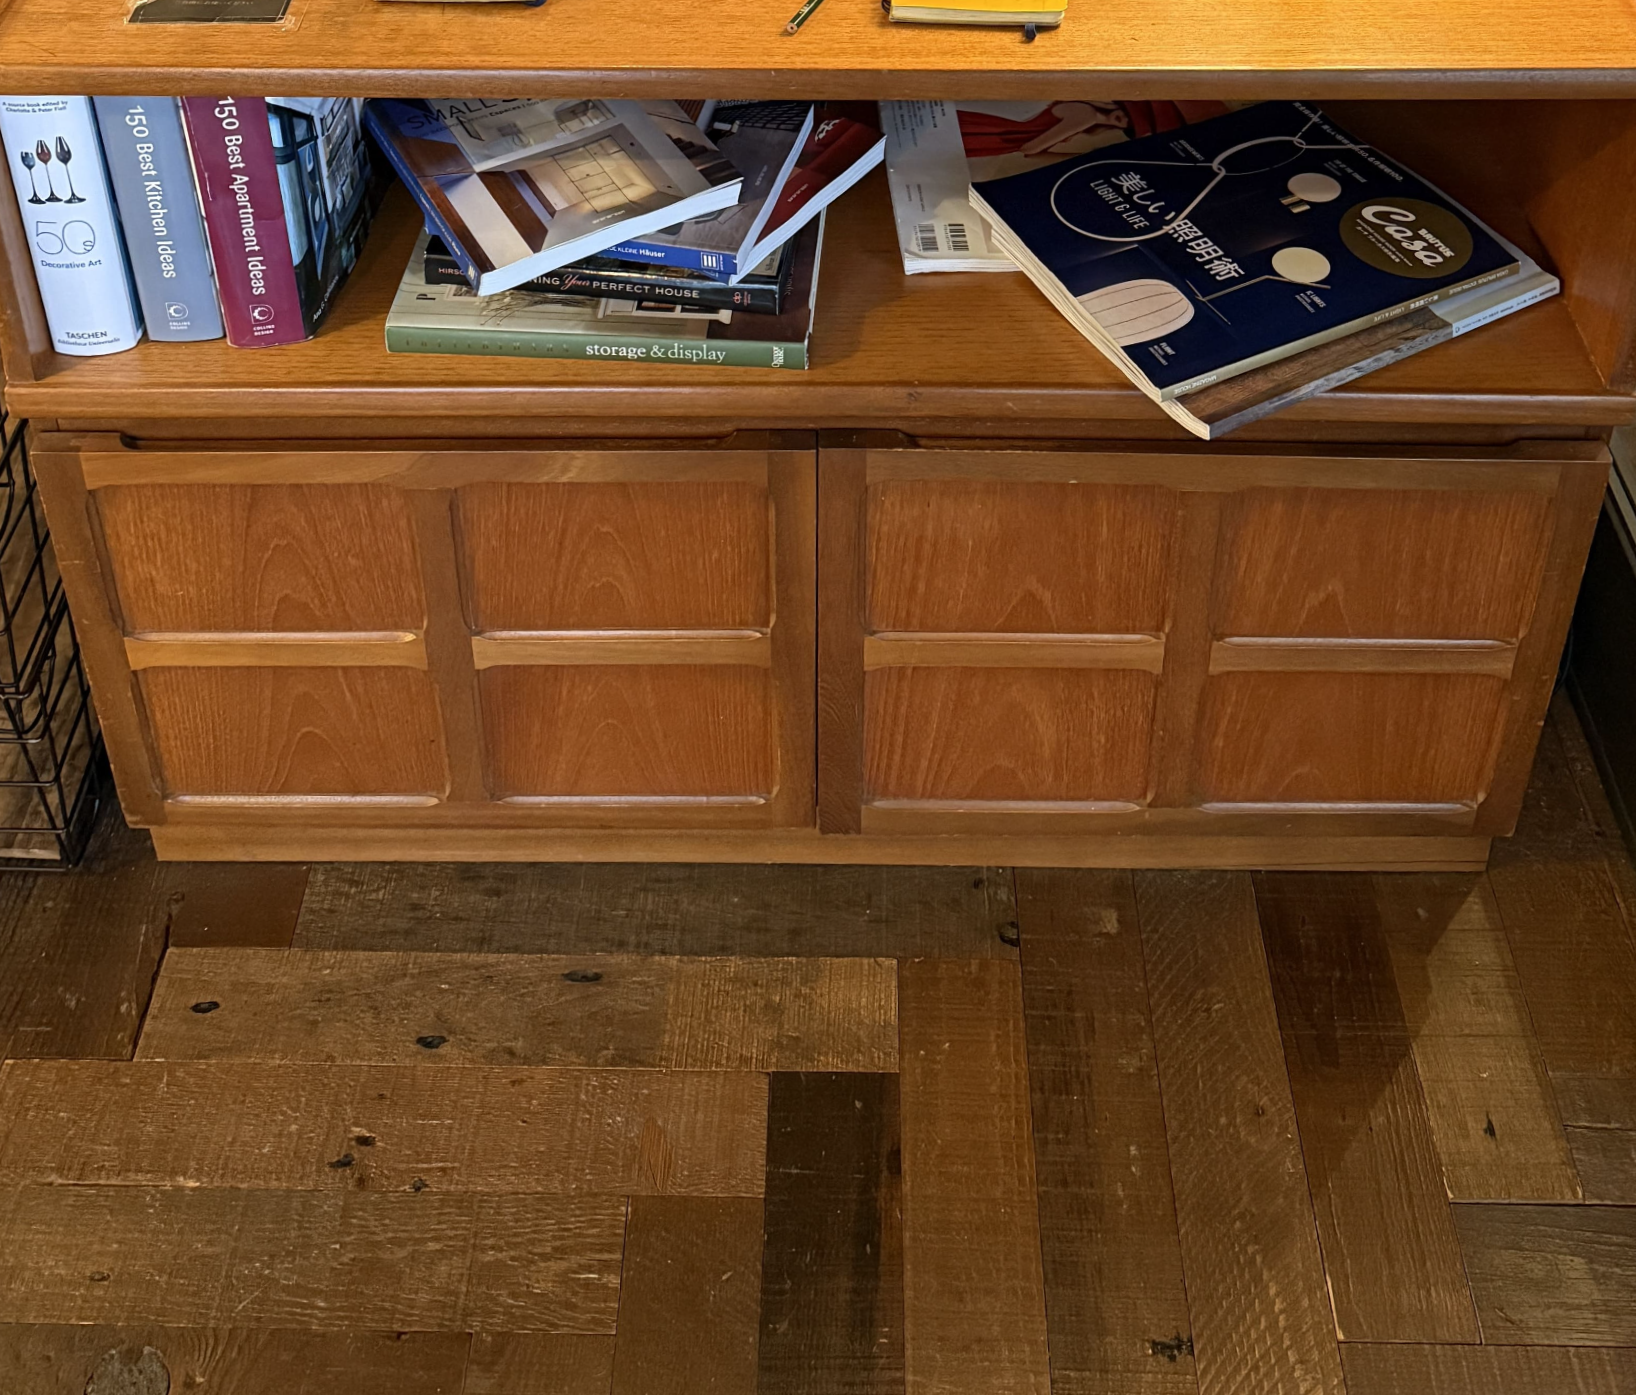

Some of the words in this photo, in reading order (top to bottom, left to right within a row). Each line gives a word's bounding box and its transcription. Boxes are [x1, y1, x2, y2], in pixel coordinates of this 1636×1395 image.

[125, 105, 150, 138] 150
[214, 96, 240, 130] 150
[136, 143, 157, 177] Best
[224, 134, 246, 169] Best
[143, 180, 168, 237] Kitchen
[229, 173, 261, 253] Apartment
[1089, 179, 1120, 205] LIGHT
[1121, 209, 1151, 230] LIFE
[1110, 171, 1246, 281] 美しい照明術
[1361, 205, 1445, 267] Casa
[1417, 228, 1455, 258] BRUTUS
[41, 259, 86, 269] Decorative
[88, 259, 102, 267] Art
[156, 240, 177, 279] Ideas
[639, 248, 666, 258] Häuser
[247, 255, 267, 296] Ideas
[561, 273, 591, 290] Your
[592, 281, 651, 294] PERFECT
[655, 287, 701, 299] HOUSE
[65, 330, 108, 340] TASCHEN
[585, 344, 647, 360] storage
[650, 345, 667, 359] &
[667, 342, 727, 364] display
